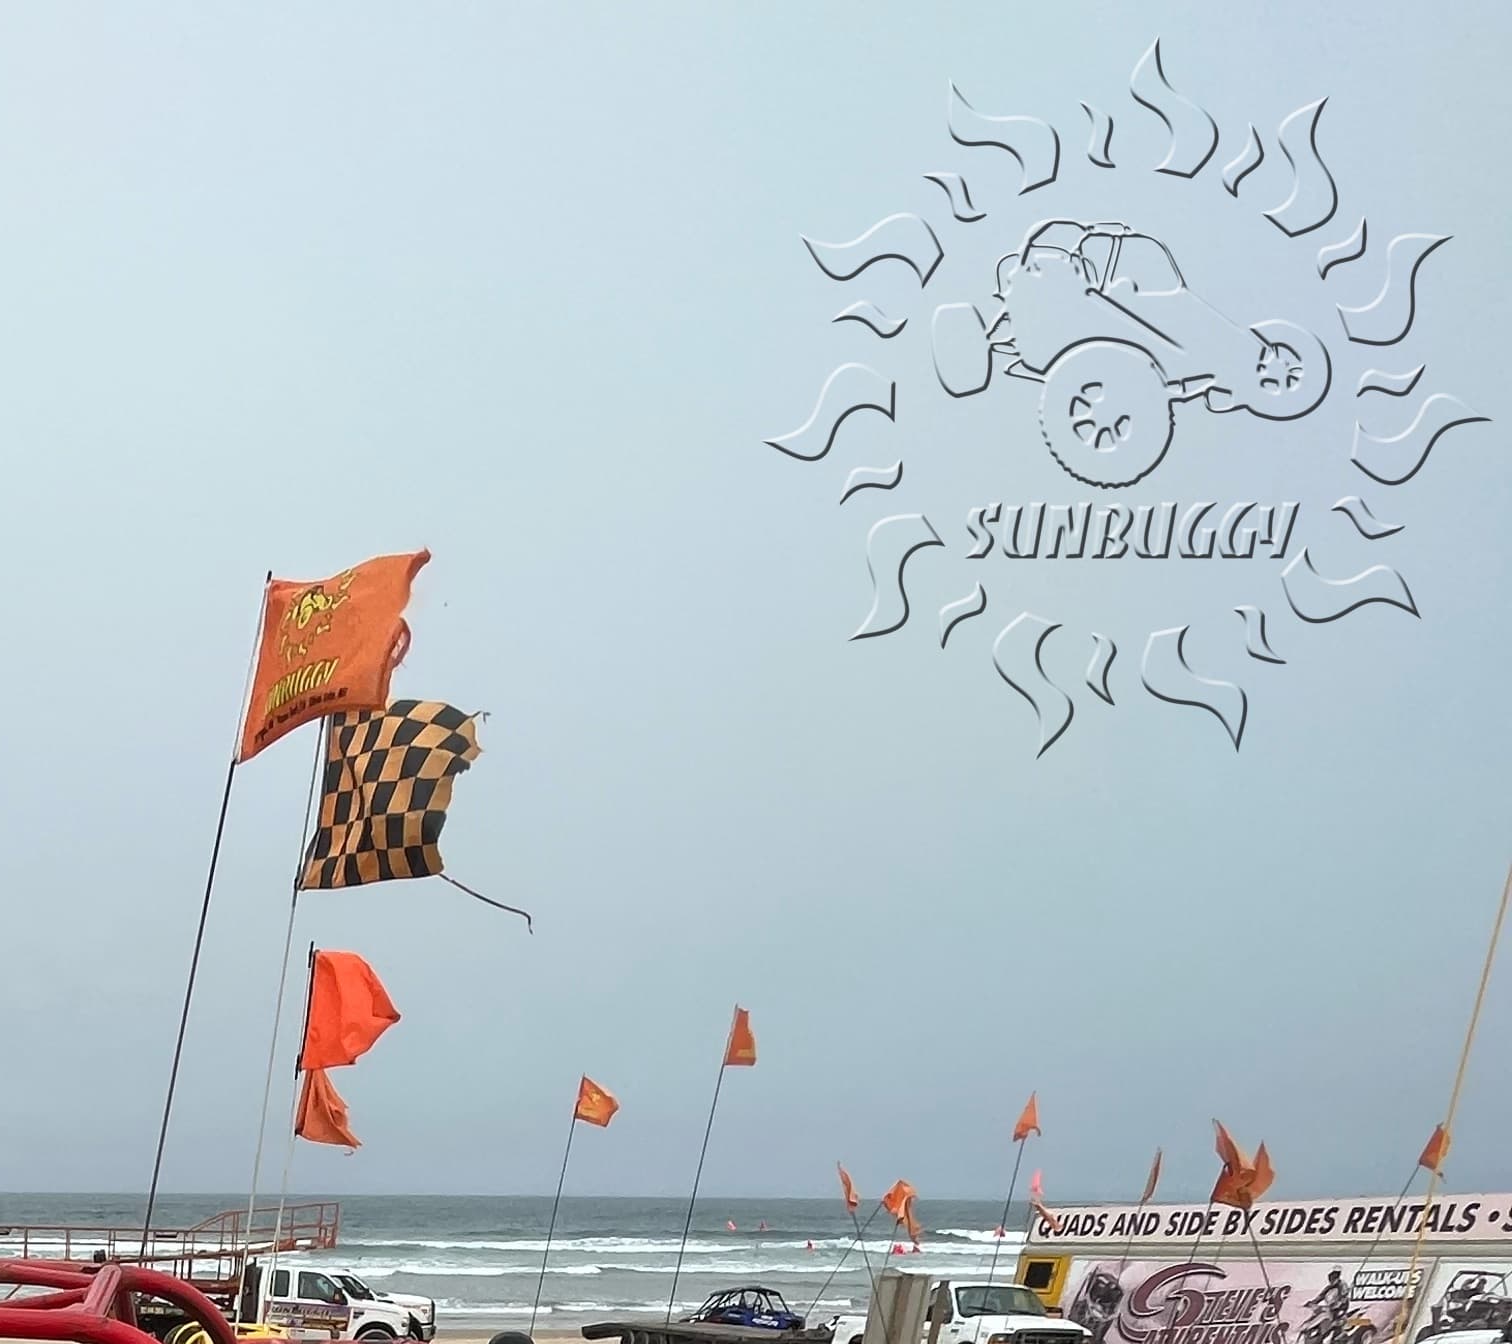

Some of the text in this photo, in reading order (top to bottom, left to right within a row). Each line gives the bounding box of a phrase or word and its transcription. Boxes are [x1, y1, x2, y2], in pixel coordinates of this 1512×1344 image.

[1038, 1213, 1108, 1238] QUADS
[1109, 1212, 1160, 1237] AND
[1164, 1211, 1220, 1236] SIDE
[1222, 1209, 1261, 1235] BY
[1260, 1207, 1340, 1235] SIDES
[1342, 1203, 1481, 1233] RENTALS
